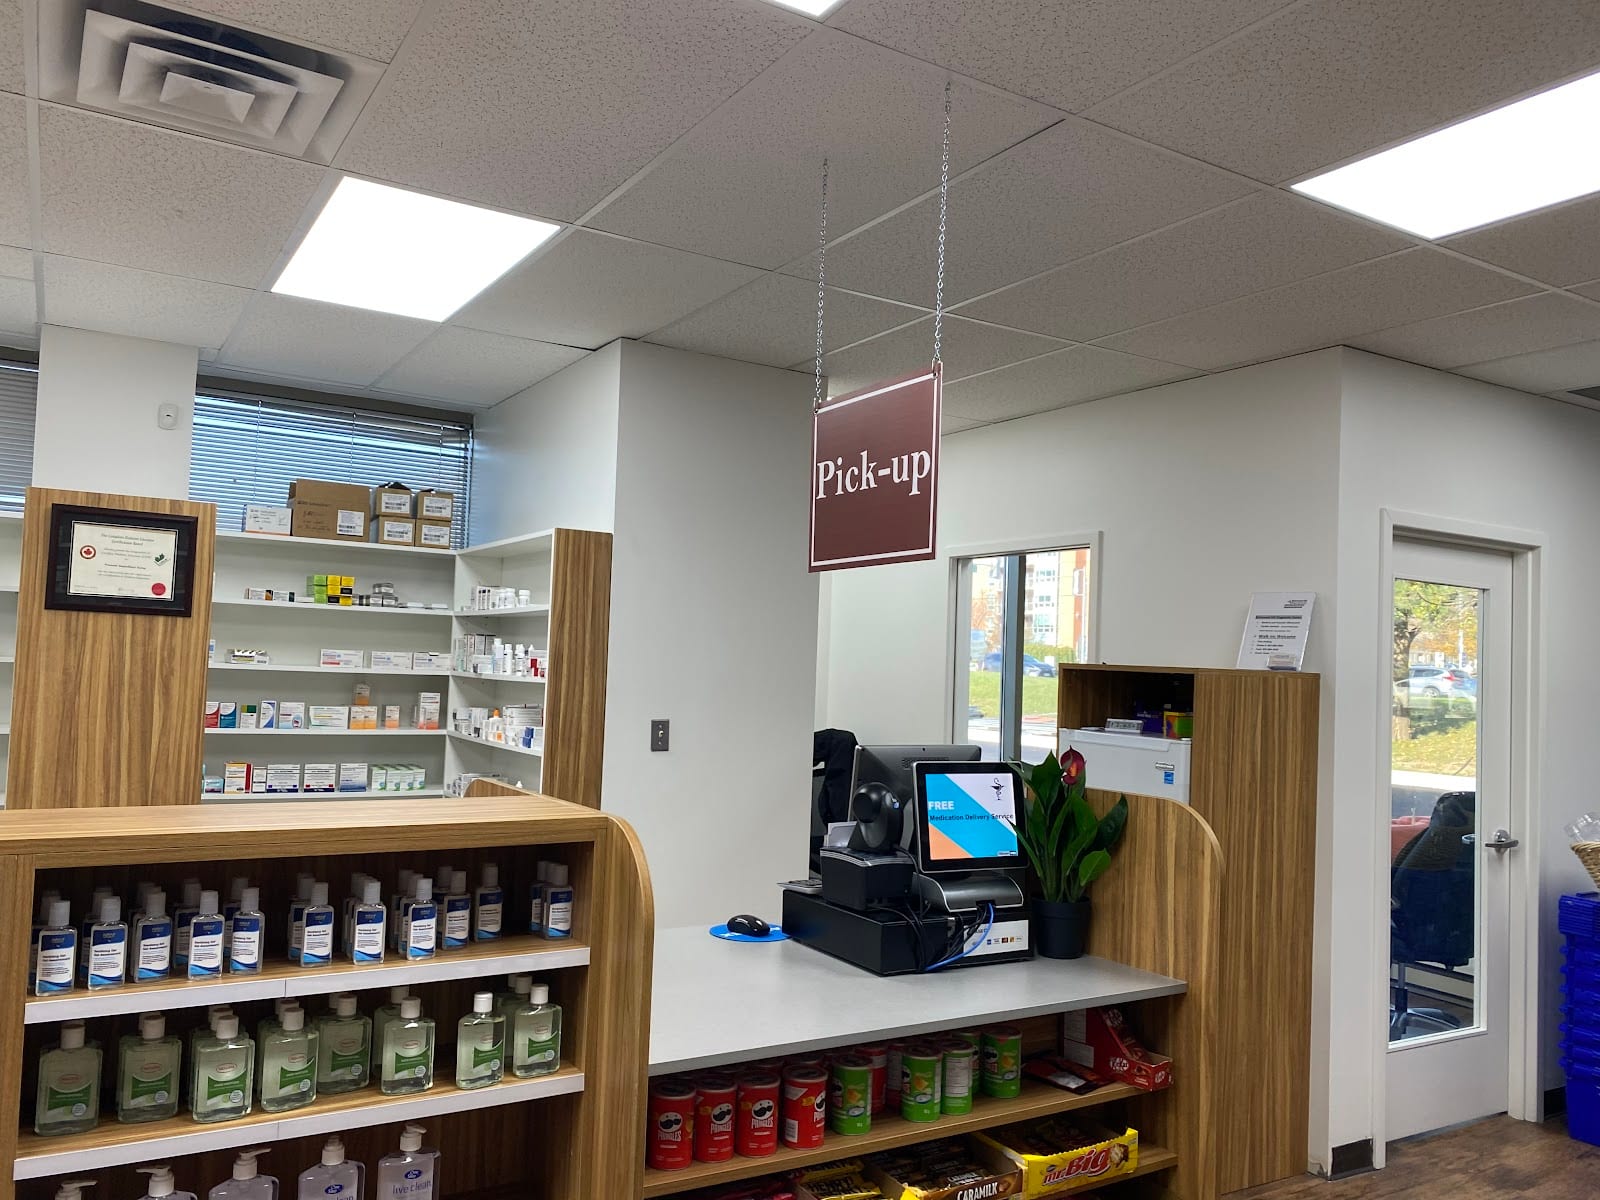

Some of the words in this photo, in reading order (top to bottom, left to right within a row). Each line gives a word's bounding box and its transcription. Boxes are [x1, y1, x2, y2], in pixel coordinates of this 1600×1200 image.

[816, 450, 931, 499] Pick-up
[928, 801, 954, 810] FREE
[392, 1185, 409, 1194] live
[957, 1182, 998, 1200] CARAMILK
